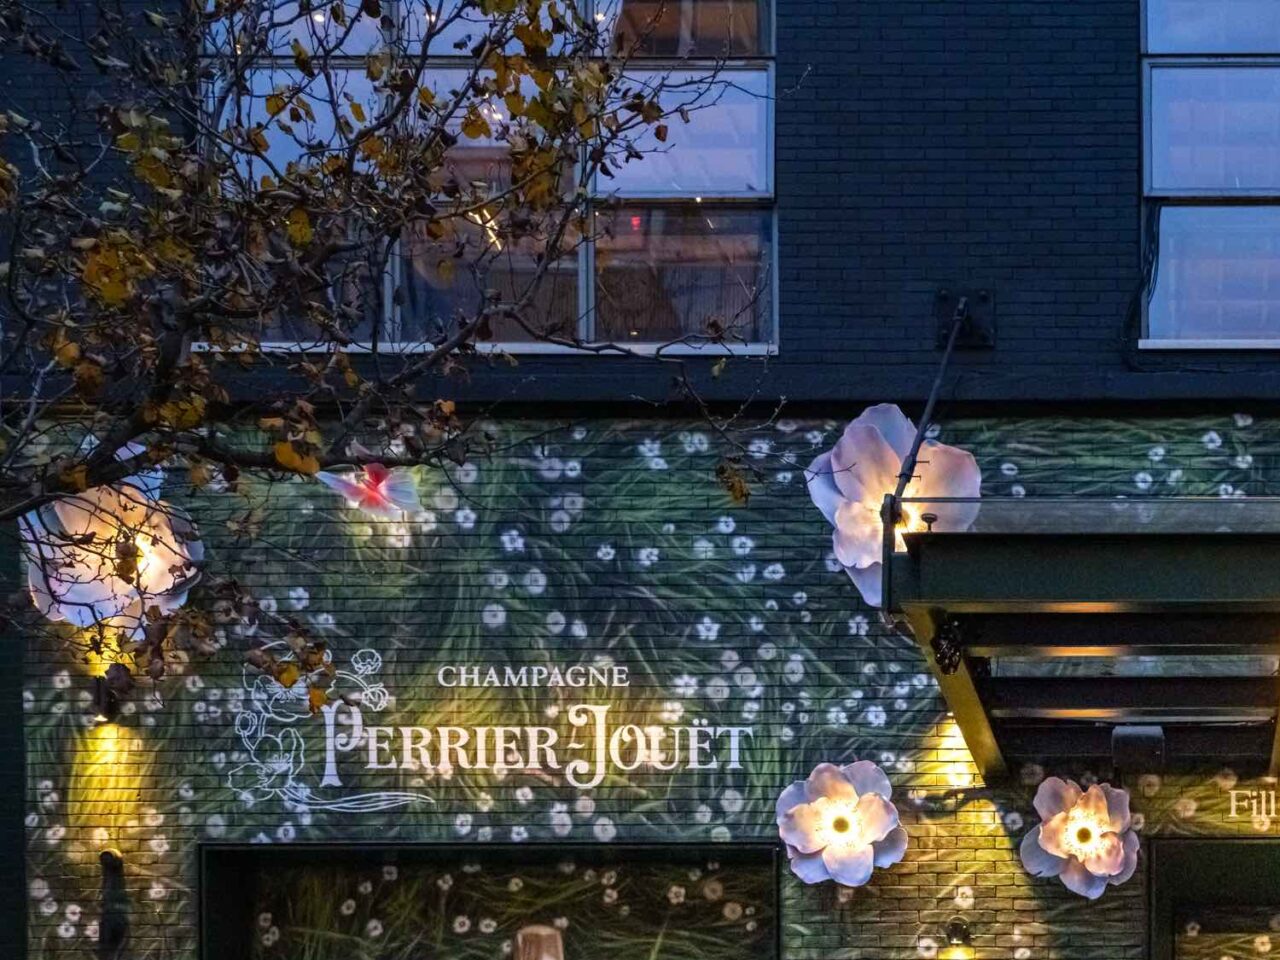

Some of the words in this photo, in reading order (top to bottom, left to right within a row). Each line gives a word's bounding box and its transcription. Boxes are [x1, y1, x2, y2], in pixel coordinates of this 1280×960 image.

[438, 665, 630, 688] CHAMPAGNE
[318, 699, 754, 789] PERRIER-JOUËT
[1228, 790, 1276, 818] Fill
